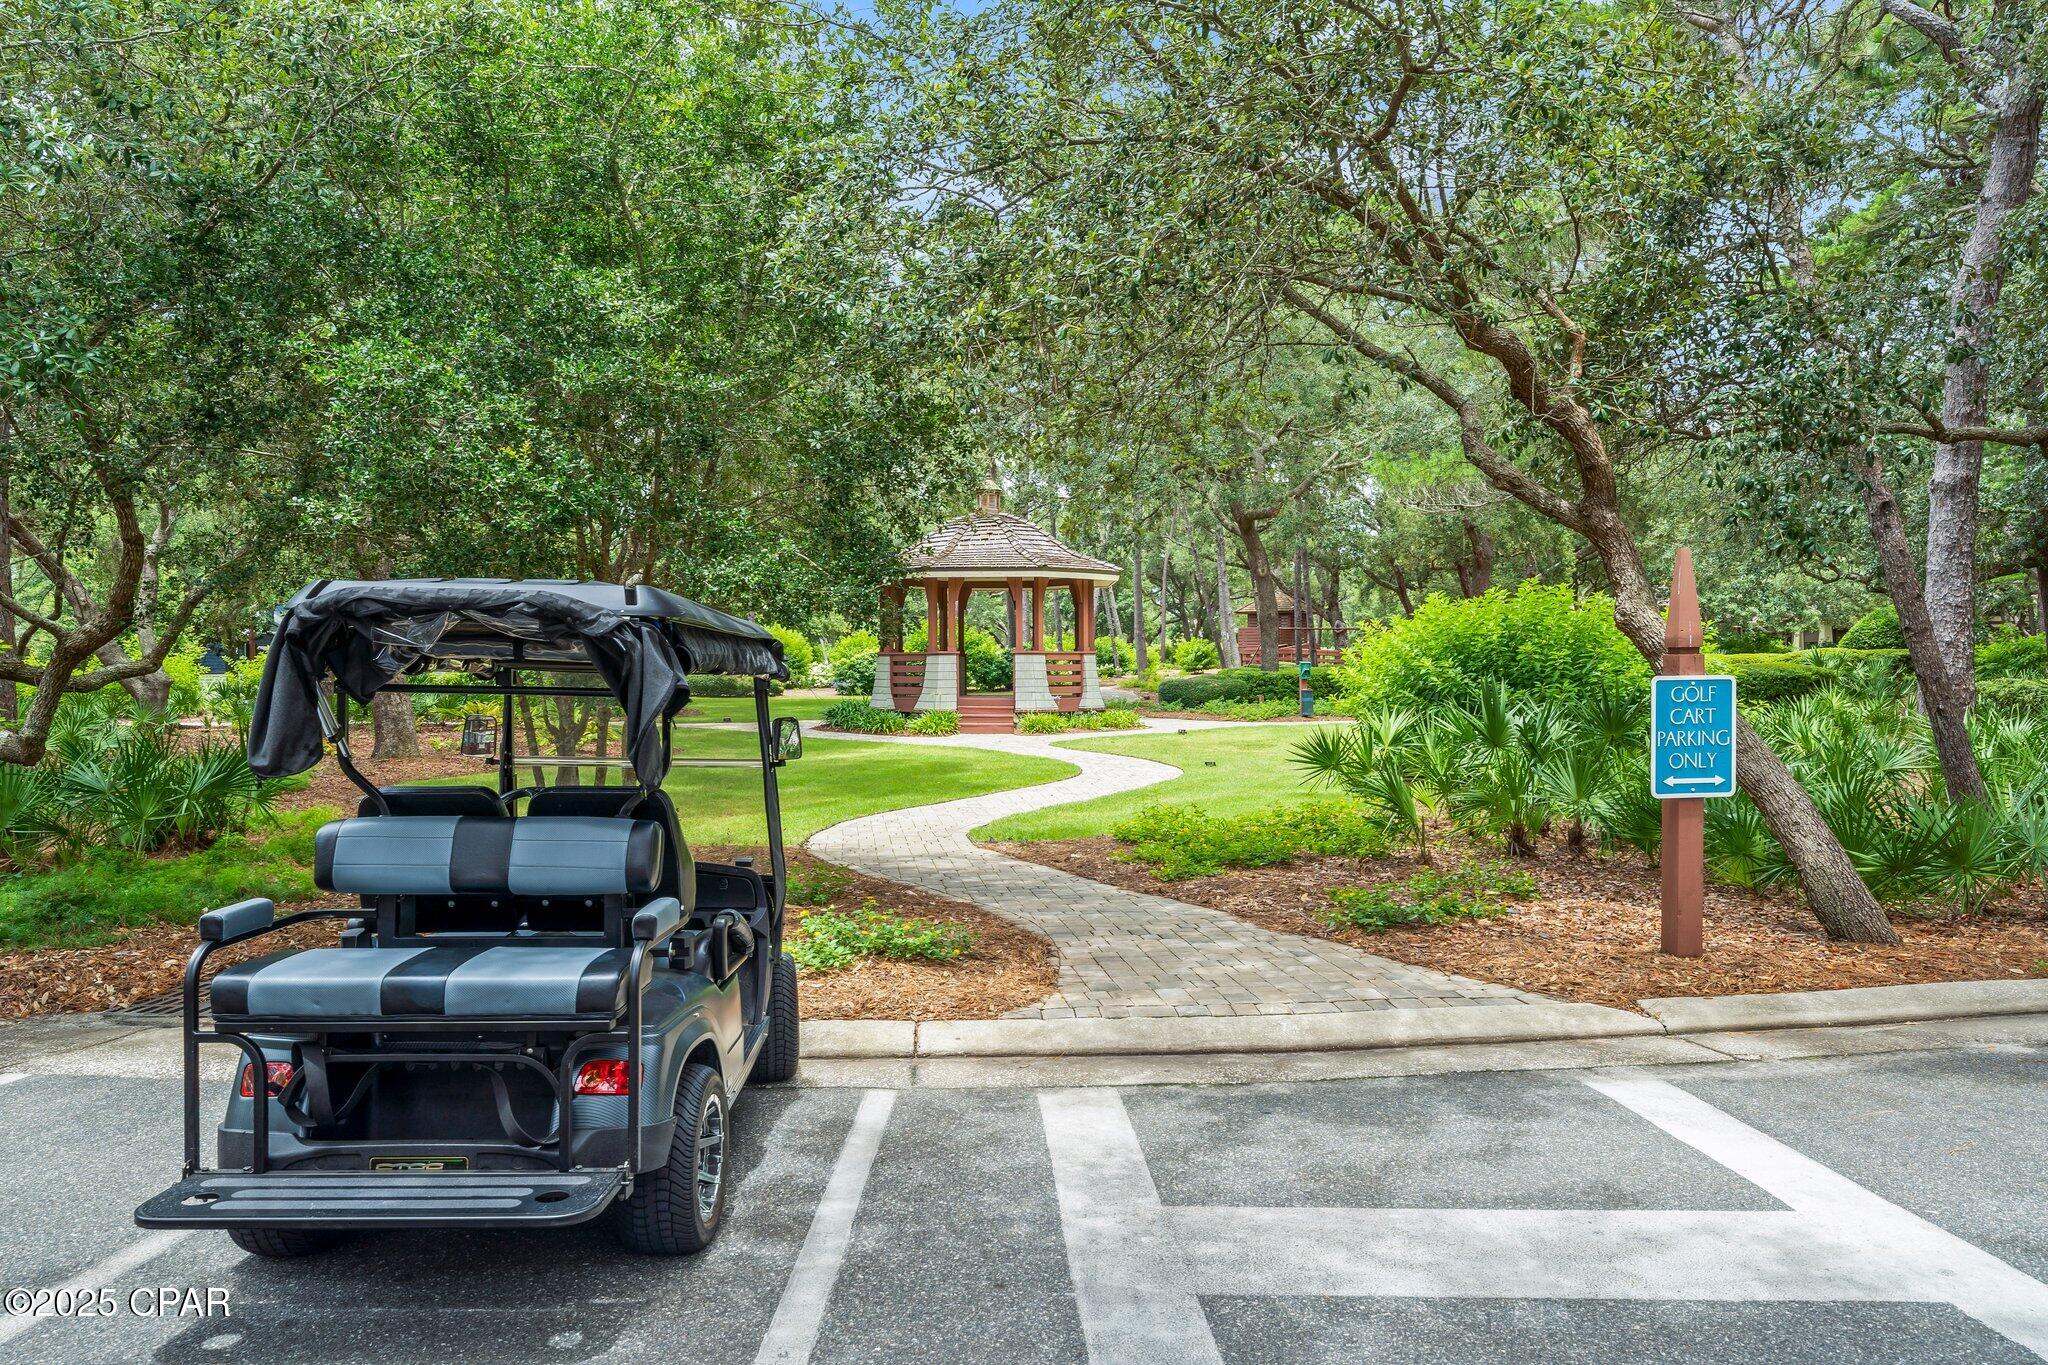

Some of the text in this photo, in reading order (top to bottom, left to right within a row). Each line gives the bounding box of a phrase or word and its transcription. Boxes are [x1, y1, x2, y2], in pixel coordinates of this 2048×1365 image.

[1671, 686, 1717, 702] GOLF
[1670, 708, 1716, 725] CART
[1657, 730, 1730, 747] PARKING
[1669, 752, 1717, 769] ONLY
